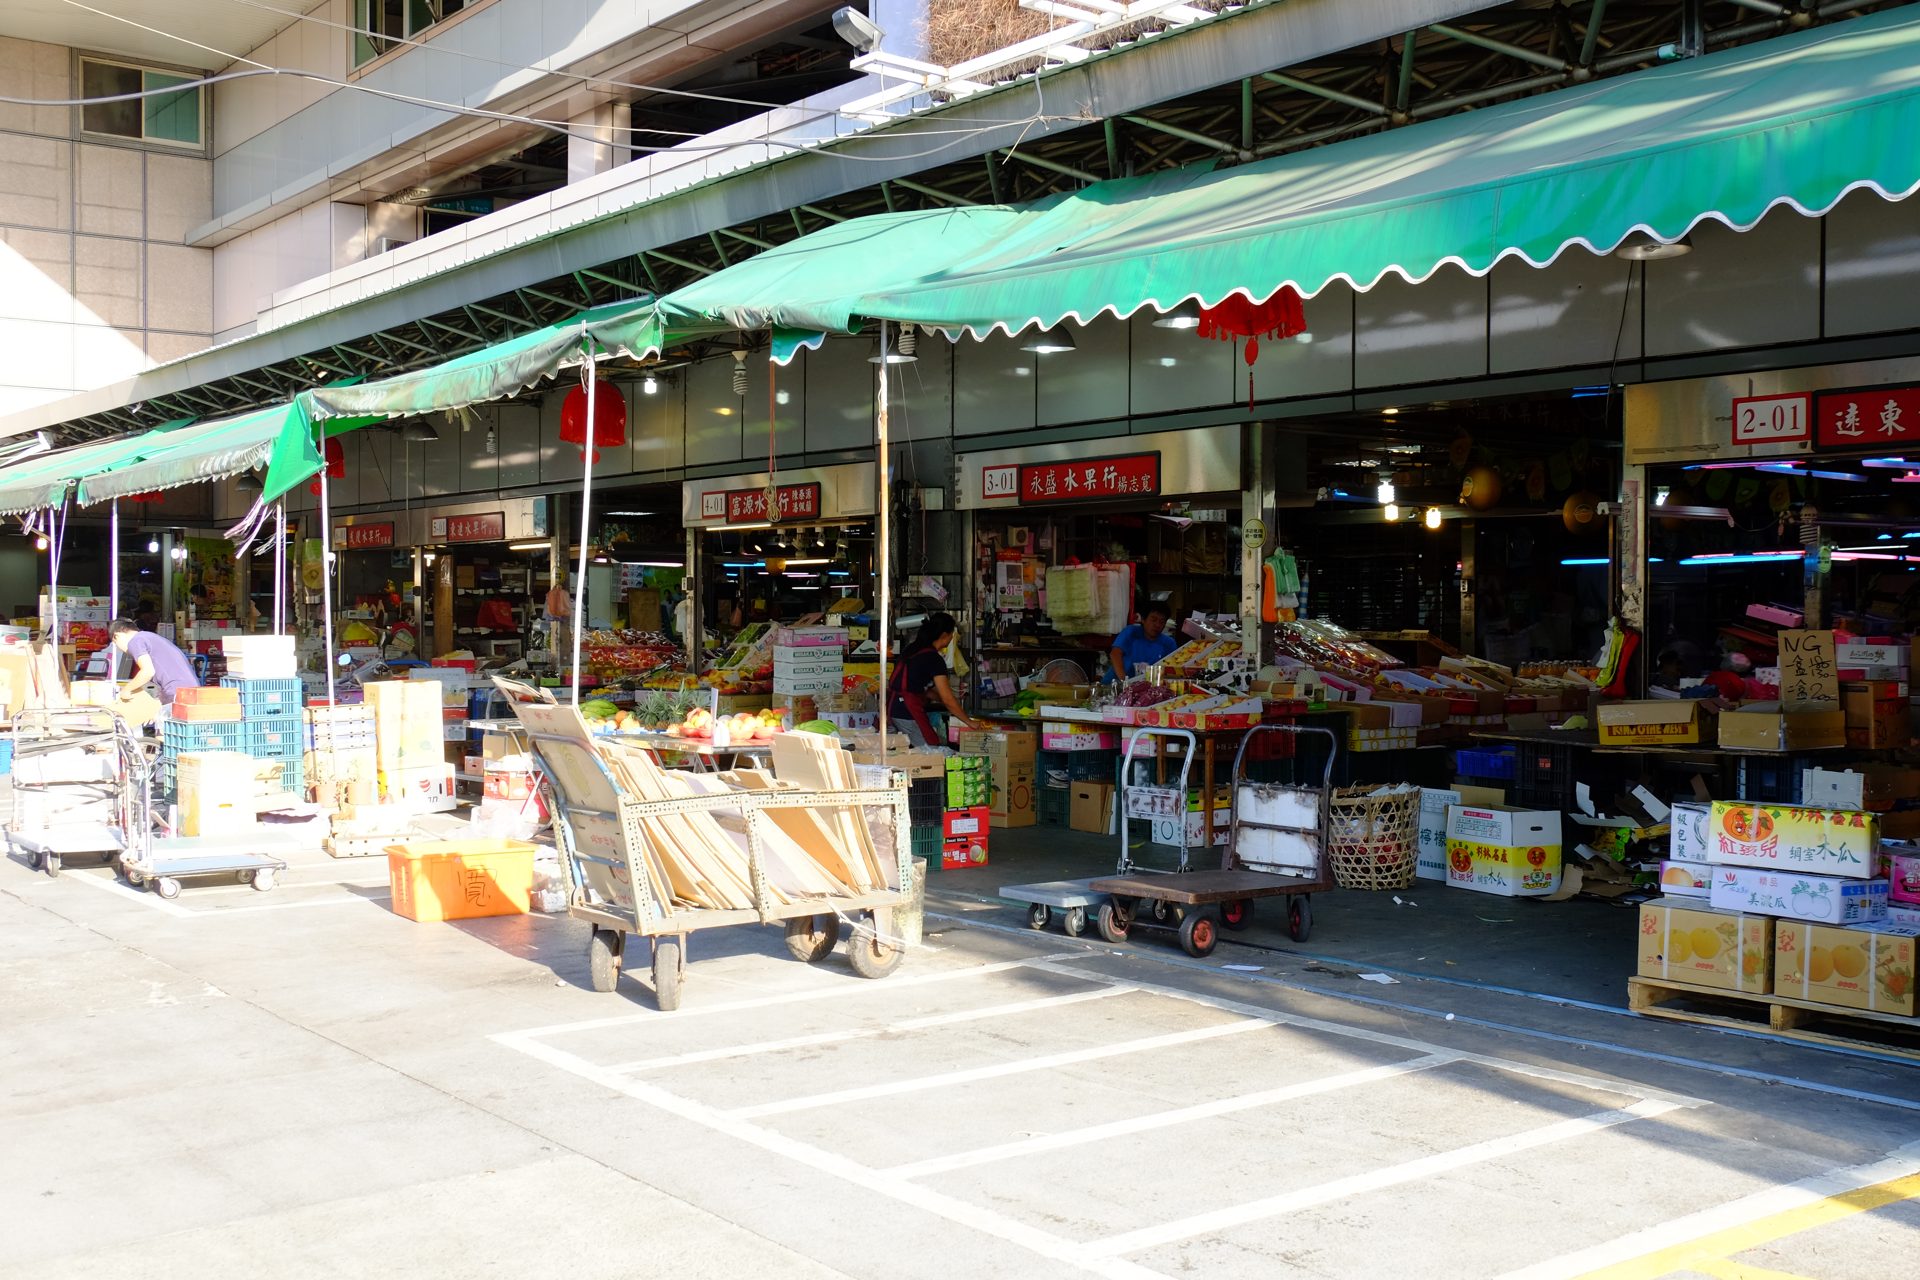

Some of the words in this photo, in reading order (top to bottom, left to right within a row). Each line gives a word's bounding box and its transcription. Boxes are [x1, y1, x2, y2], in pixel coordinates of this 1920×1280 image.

[1743, 403, 1801, 434] 2-01
[1834, 399, 1920, 437] 遠東
[987, 472, 1015, 491] 3-01
[705, 497, 723, 513] 4-01
[732, 492, 789, 517] 富源水行
[1784, 634, 1822, 656] NG
